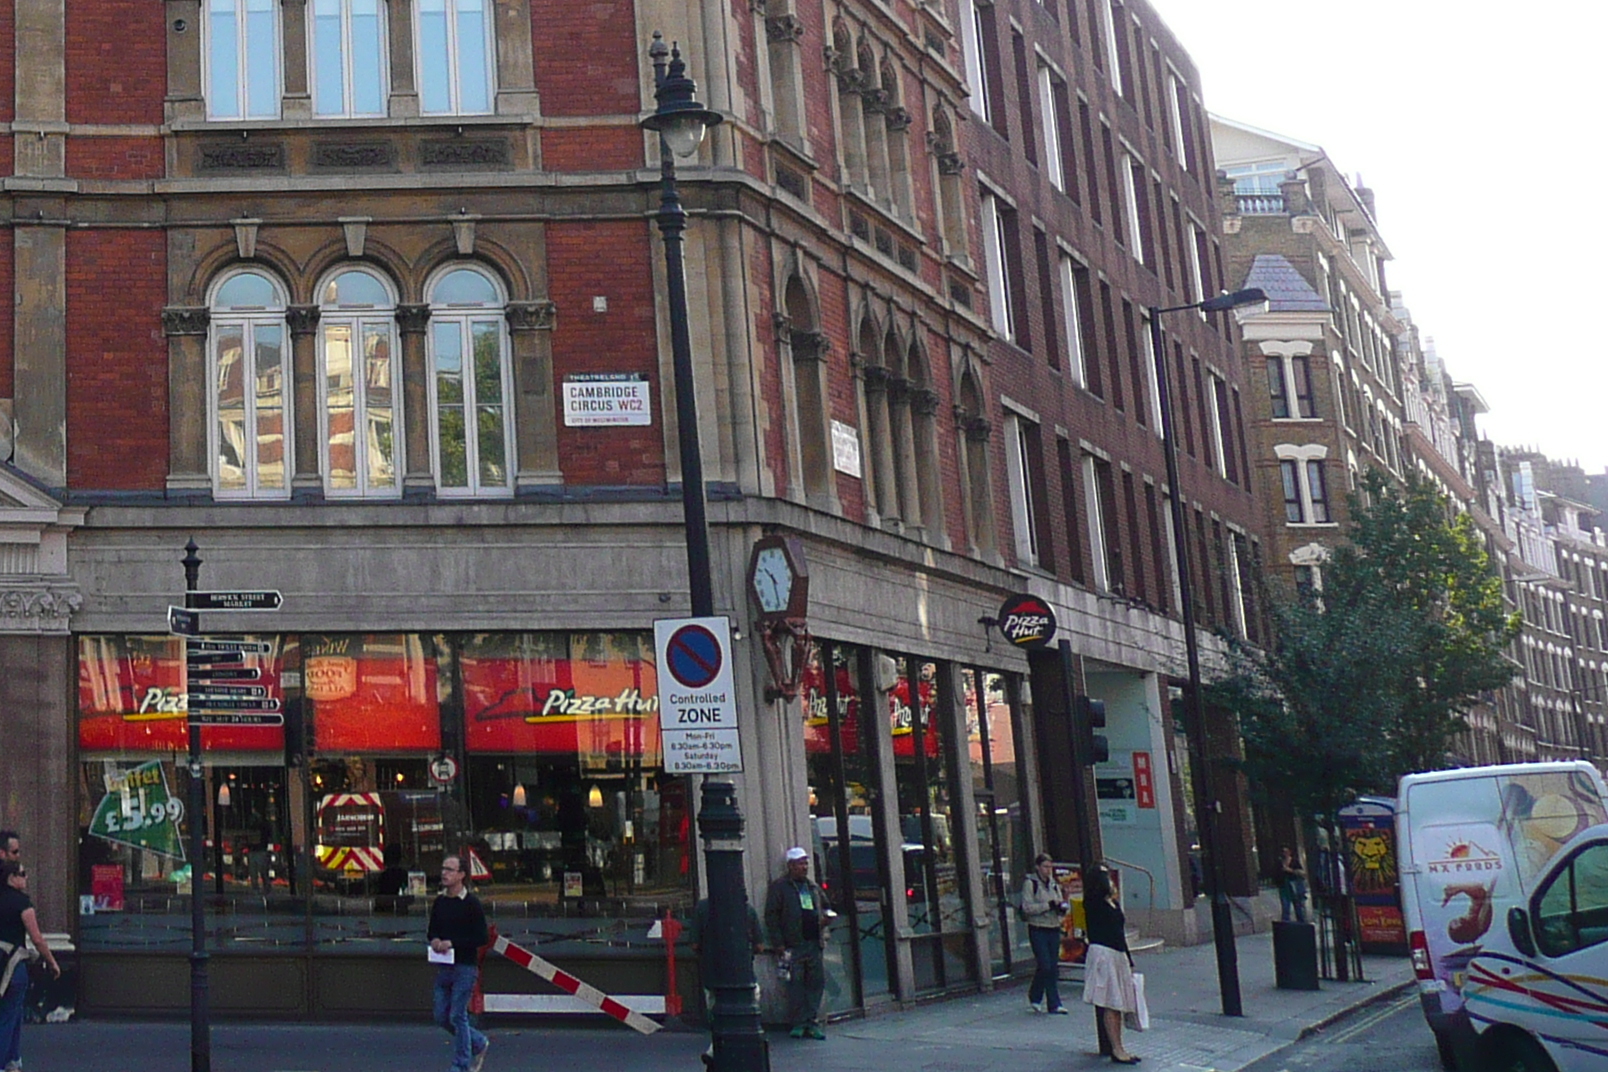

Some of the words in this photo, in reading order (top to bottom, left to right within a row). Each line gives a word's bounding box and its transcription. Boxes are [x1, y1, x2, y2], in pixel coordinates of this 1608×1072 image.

[570, 386, 638, 399] CAMBRIDGE
[571, 400, 613, 411] CIRCUS
[618, 399, 643, 411] WC2
[1004, 614, 1049, 632] Pizza
[1011, 625, 1044, 639] Hut
[139, 686, 188, 715] Pizz
[542, 688, 612, 716] Pizza
[669, 692, 726, 704] Controlled
[677, 707, 722, 723] ZONE
[685, 732, 715, 740] Mon-Fri
[684, 752, 718, 761] Saturday
[104, 797, 181, 833] £5.99
